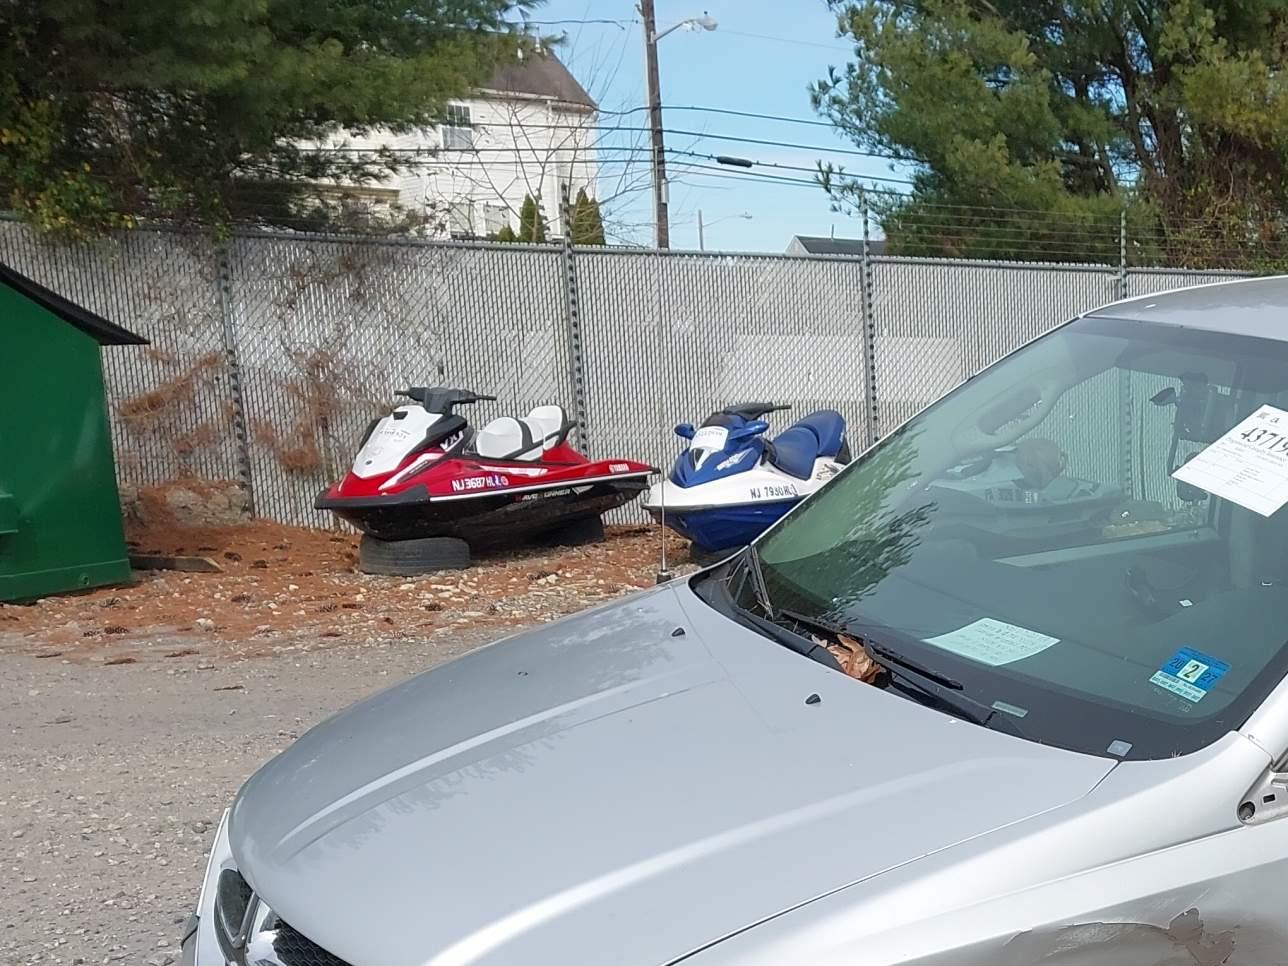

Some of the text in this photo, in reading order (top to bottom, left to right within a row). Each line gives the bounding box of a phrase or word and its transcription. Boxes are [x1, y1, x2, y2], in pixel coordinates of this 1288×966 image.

[451, 479, 465, 491] NJ
[465, 477, 486, 490] 3687
[515, 488, 571, 501] AVEUNNER
[750, 488, 761, 499] NJ
[1183, 664, 1200, 679] 2
